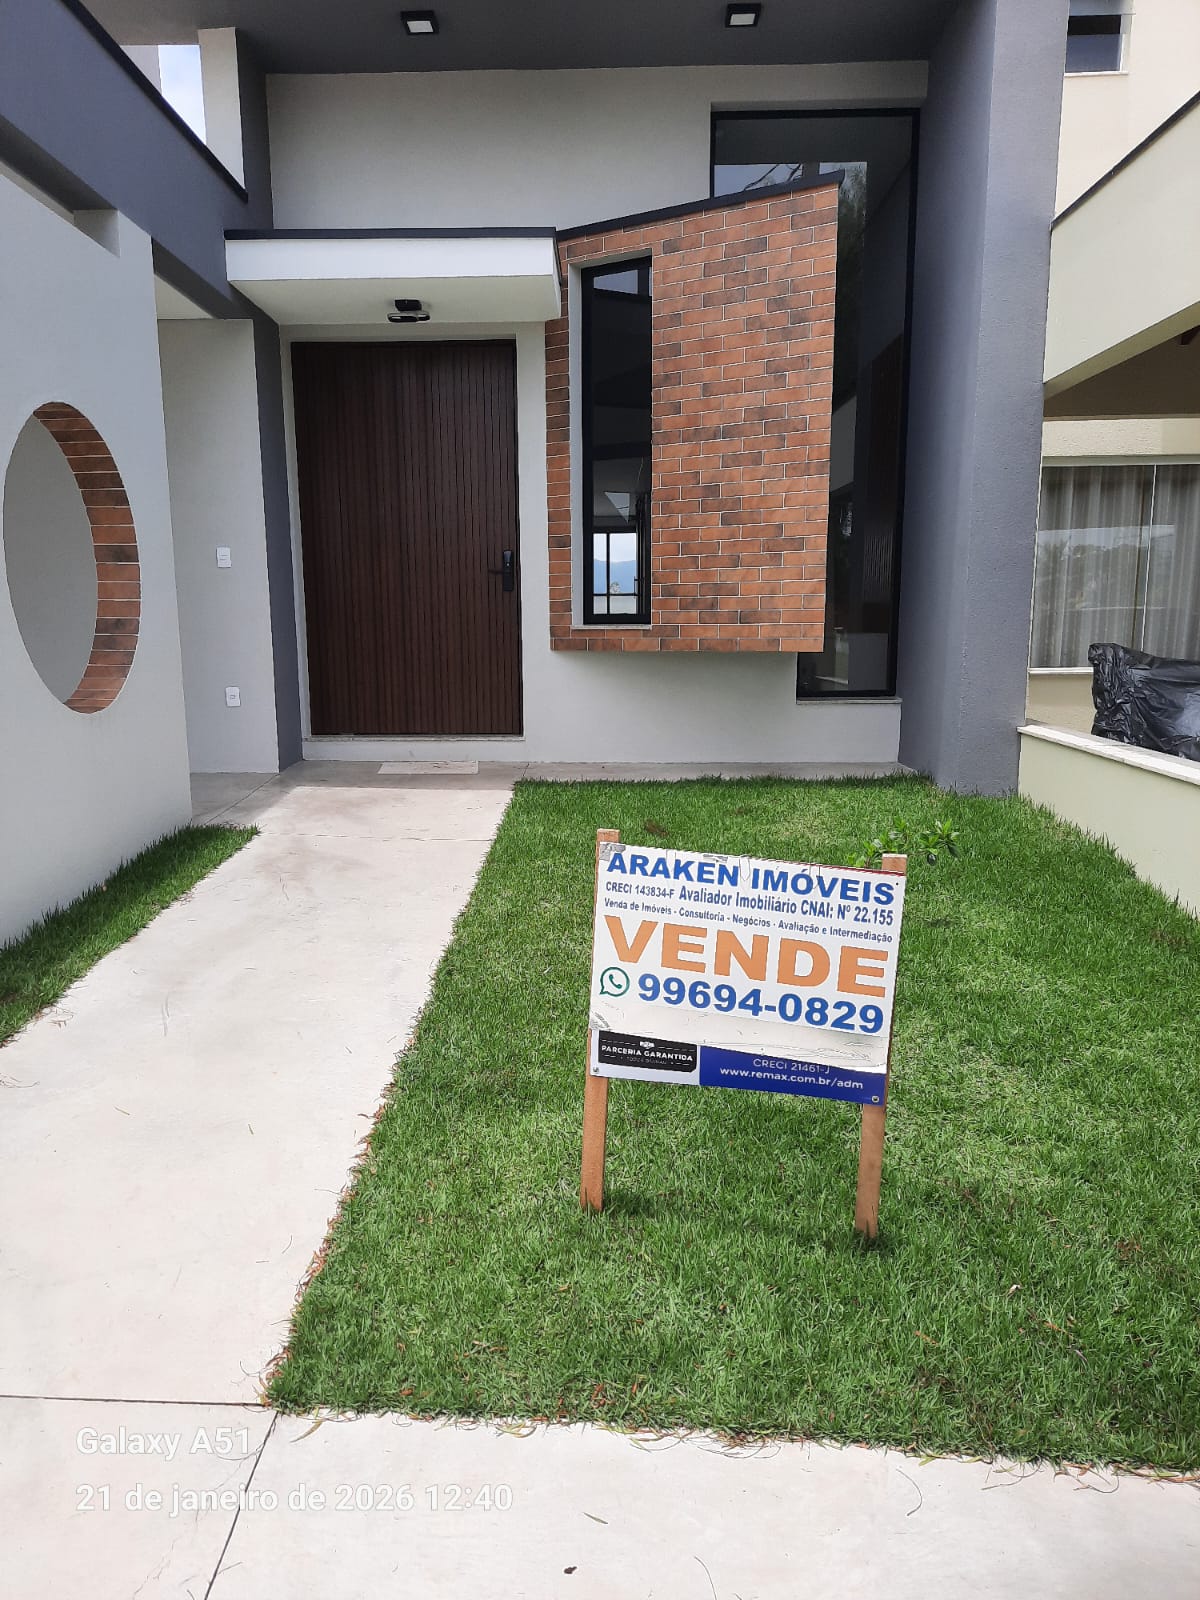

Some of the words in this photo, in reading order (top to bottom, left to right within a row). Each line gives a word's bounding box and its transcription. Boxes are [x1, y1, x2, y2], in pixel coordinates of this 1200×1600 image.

[607, 852, 739, 887] ARAKEN
[751, 868, 895, 906] IMÓVEIS
[604, 898, 628, 910] Venda
[630, 900, 639, 910] de
[642, 902, 672, 915] Imóveis
[679, 907, 725, 922] Consultoria
[732, 914, 771, 927] Negócios
[778, 919, 820, 934] Avaliação
[822, 927, 827, 935] e
[830, 926, 893, 943] Intermediação
[606, 881, 632, 894] CRECI
[635, 885, 675, 899] 143834-F
[679, 885, 732, 907] Avaliador
[736, 892, 797, 914] Imobiliário
[853, 906, 894, 926] 22.155
[604, 915, 889, 998] VENDE
[638, 973, 884, 1034] 99694-0829
[601, 1045, 642, 1056] PARCERIA
[644, 1050, 693, 1061] GARANTIDA
[753, 1058, 787, 1070] CRECI
[720, 1067, 864, 1090] www.remax.com.br/adm
